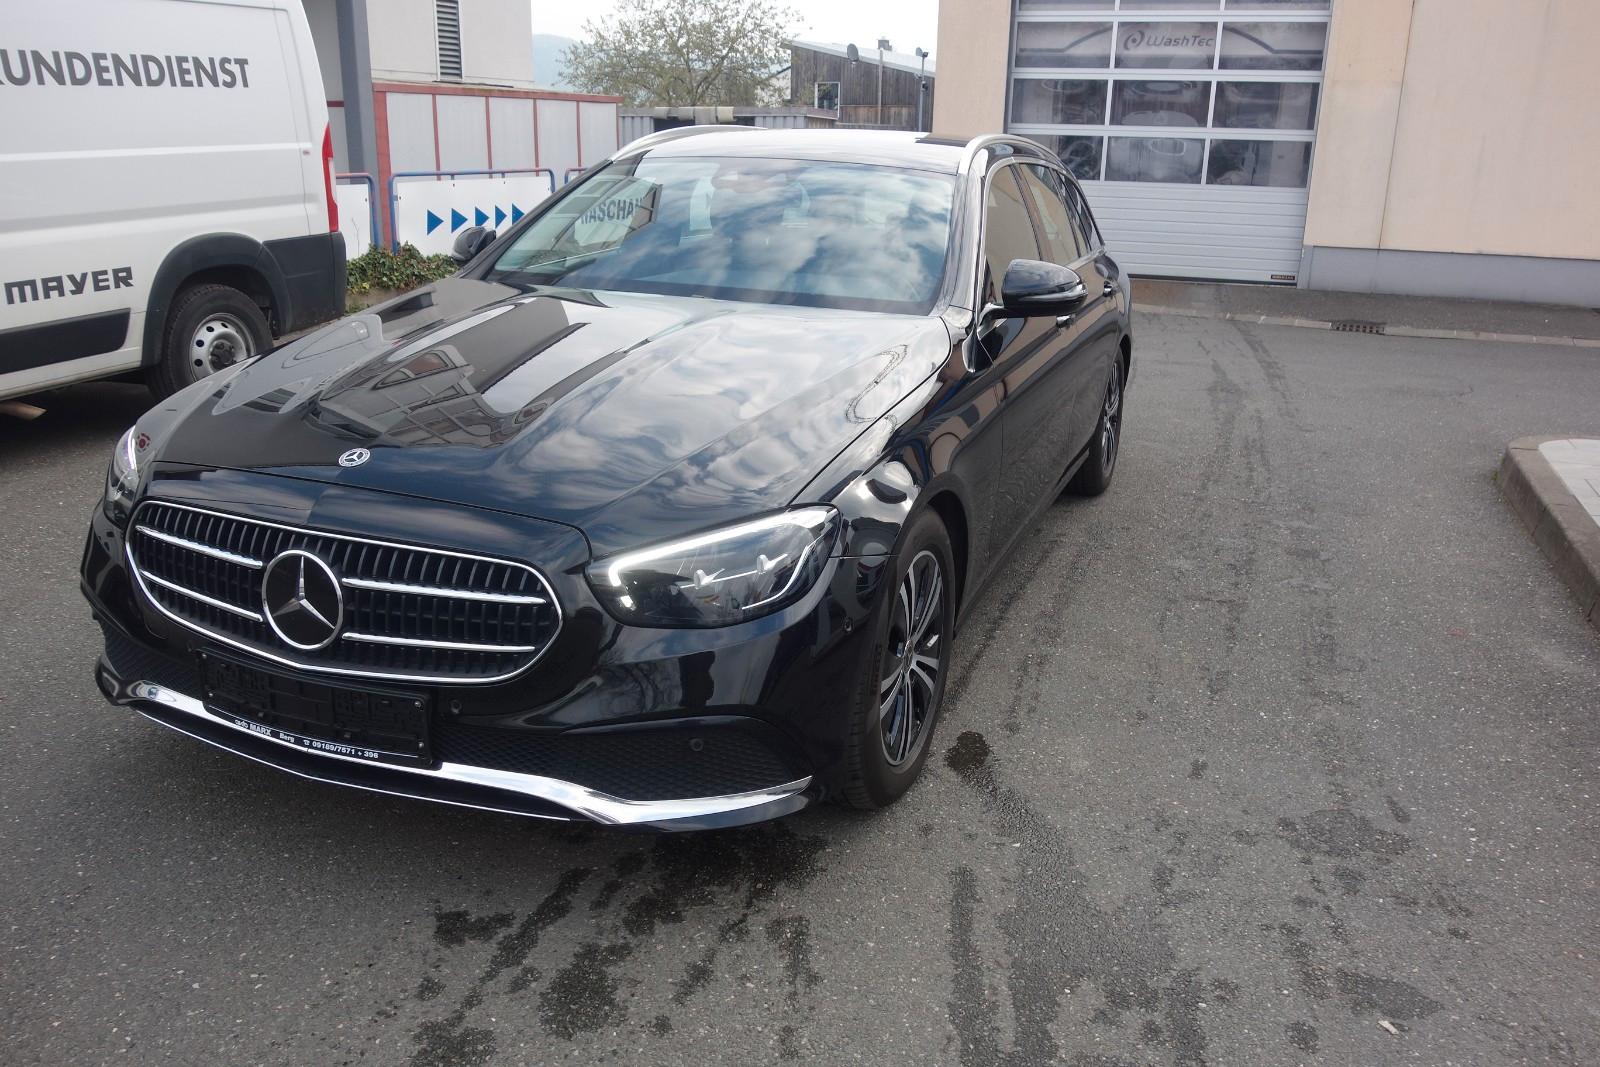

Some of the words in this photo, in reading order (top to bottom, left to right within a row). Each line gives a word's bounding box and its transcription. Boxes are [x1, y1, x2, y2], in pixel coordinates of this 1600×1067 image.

[1146, 35, 1213, 47] WashTec
[0, 48, 249, 89] UNDENDIENST
[4, 266, 134, 305] MAYER
[249, 723, 272, 737] MARX
[279, 732, 295, 743] Berg
